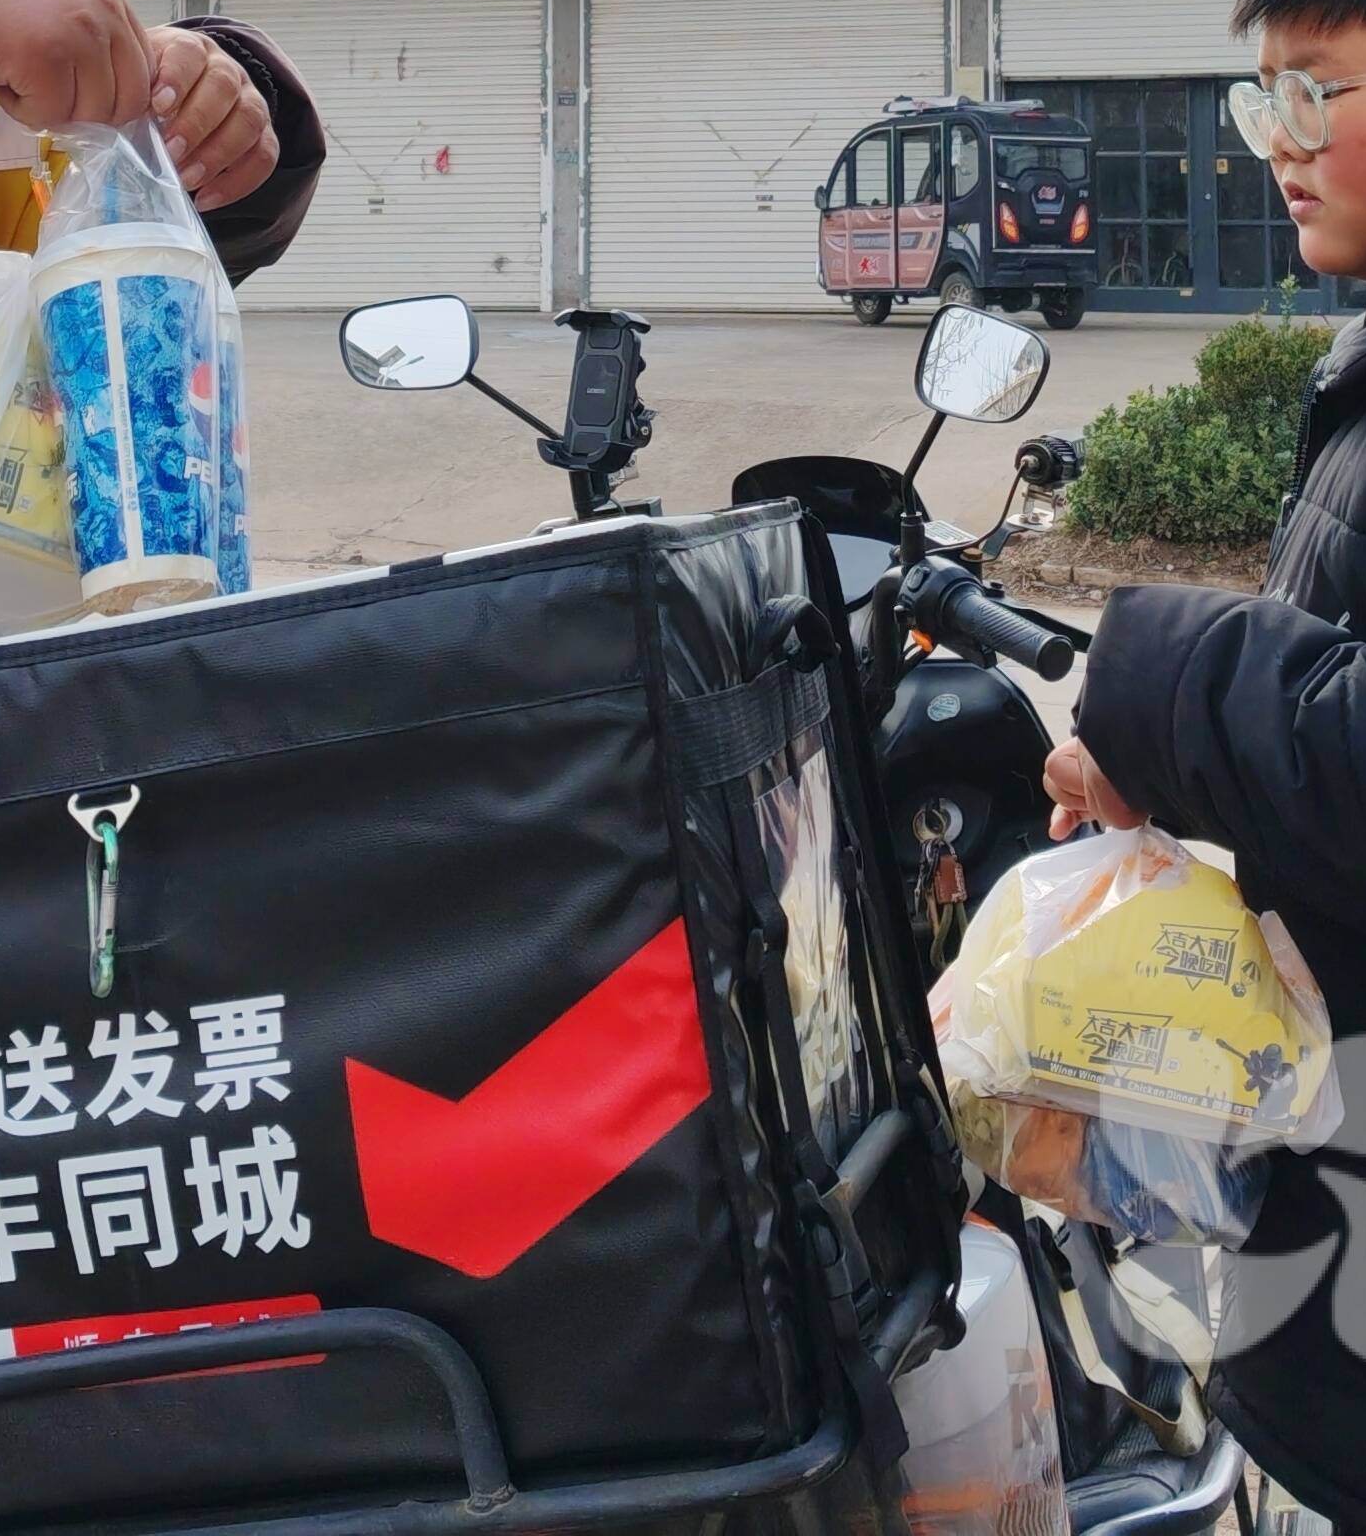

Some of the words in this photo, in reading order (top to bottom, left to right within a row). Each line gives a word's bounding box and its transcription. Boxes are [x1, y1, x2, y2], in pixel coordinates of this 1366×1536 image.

[1151, 929, 1228, 961] 大吉大利
[1075, 1015, 1163, 1050] 大吉大利
